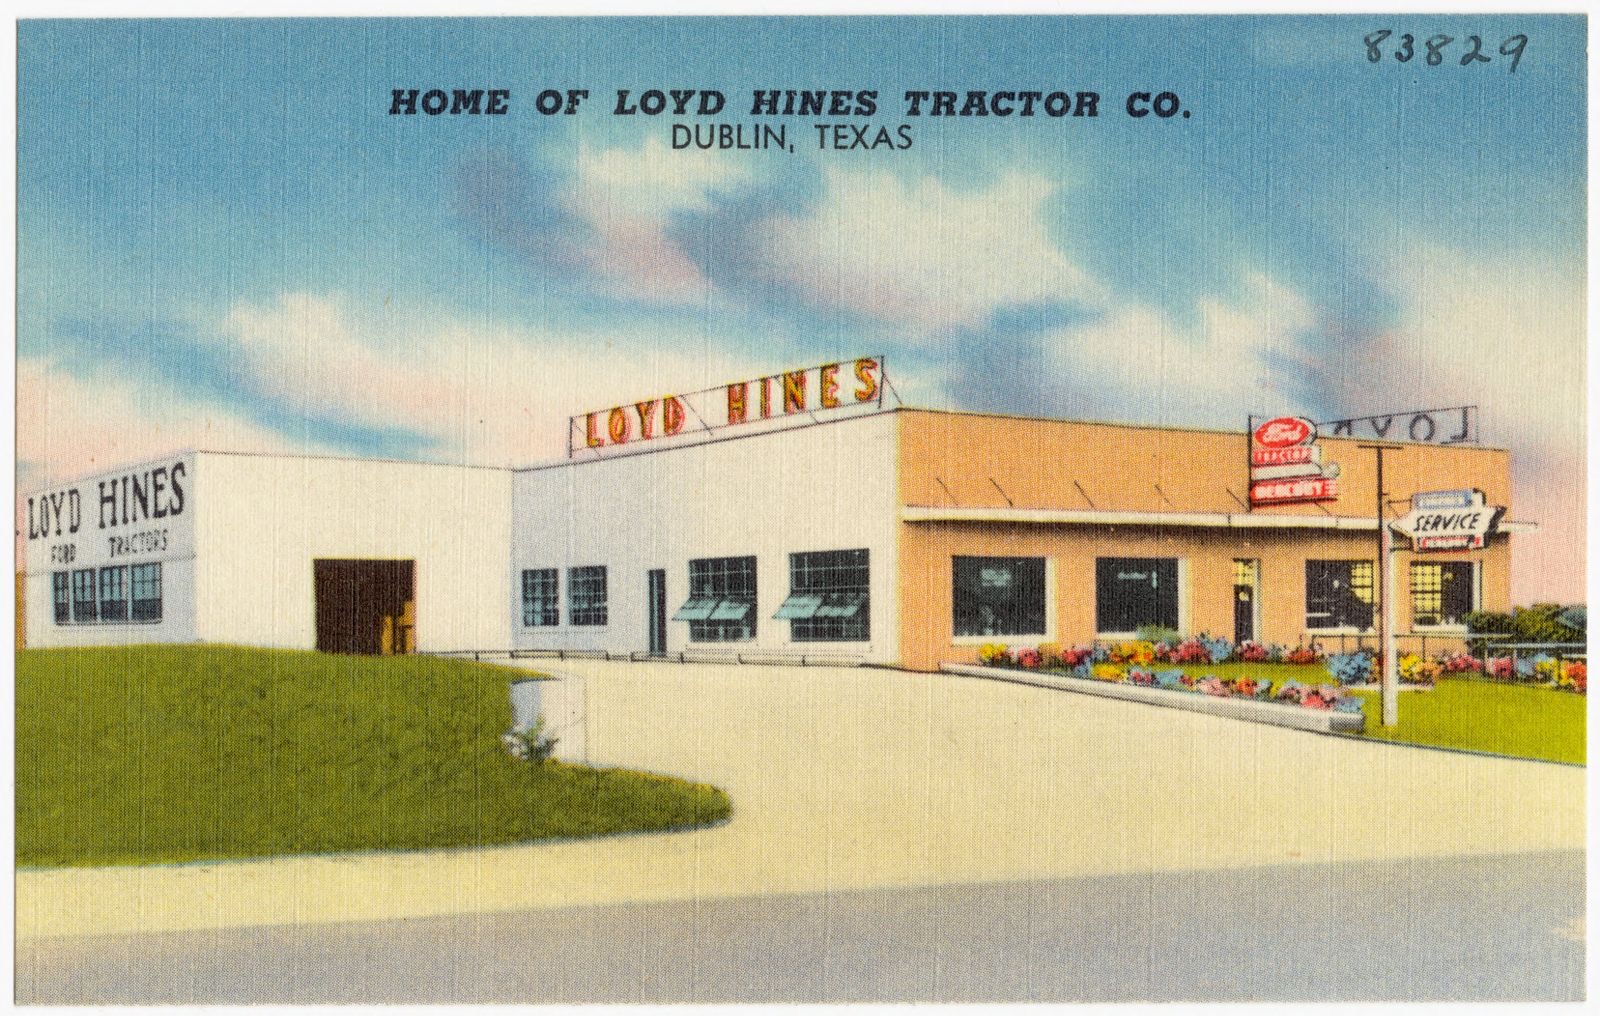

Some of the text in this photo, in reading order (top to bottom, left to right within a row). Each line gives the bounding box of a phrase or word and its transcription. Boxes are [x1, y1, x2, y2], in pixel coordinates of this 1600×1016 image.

[1364, 30, 1528, 73] 83829
[586, 357, 878, 448] LOYD HINES
[28, 461, 186, 540] LOYD HINES
[1413, 512, 1481, 532] SERVICE
[51, 529, 167, 564] FORD TRACTORS
